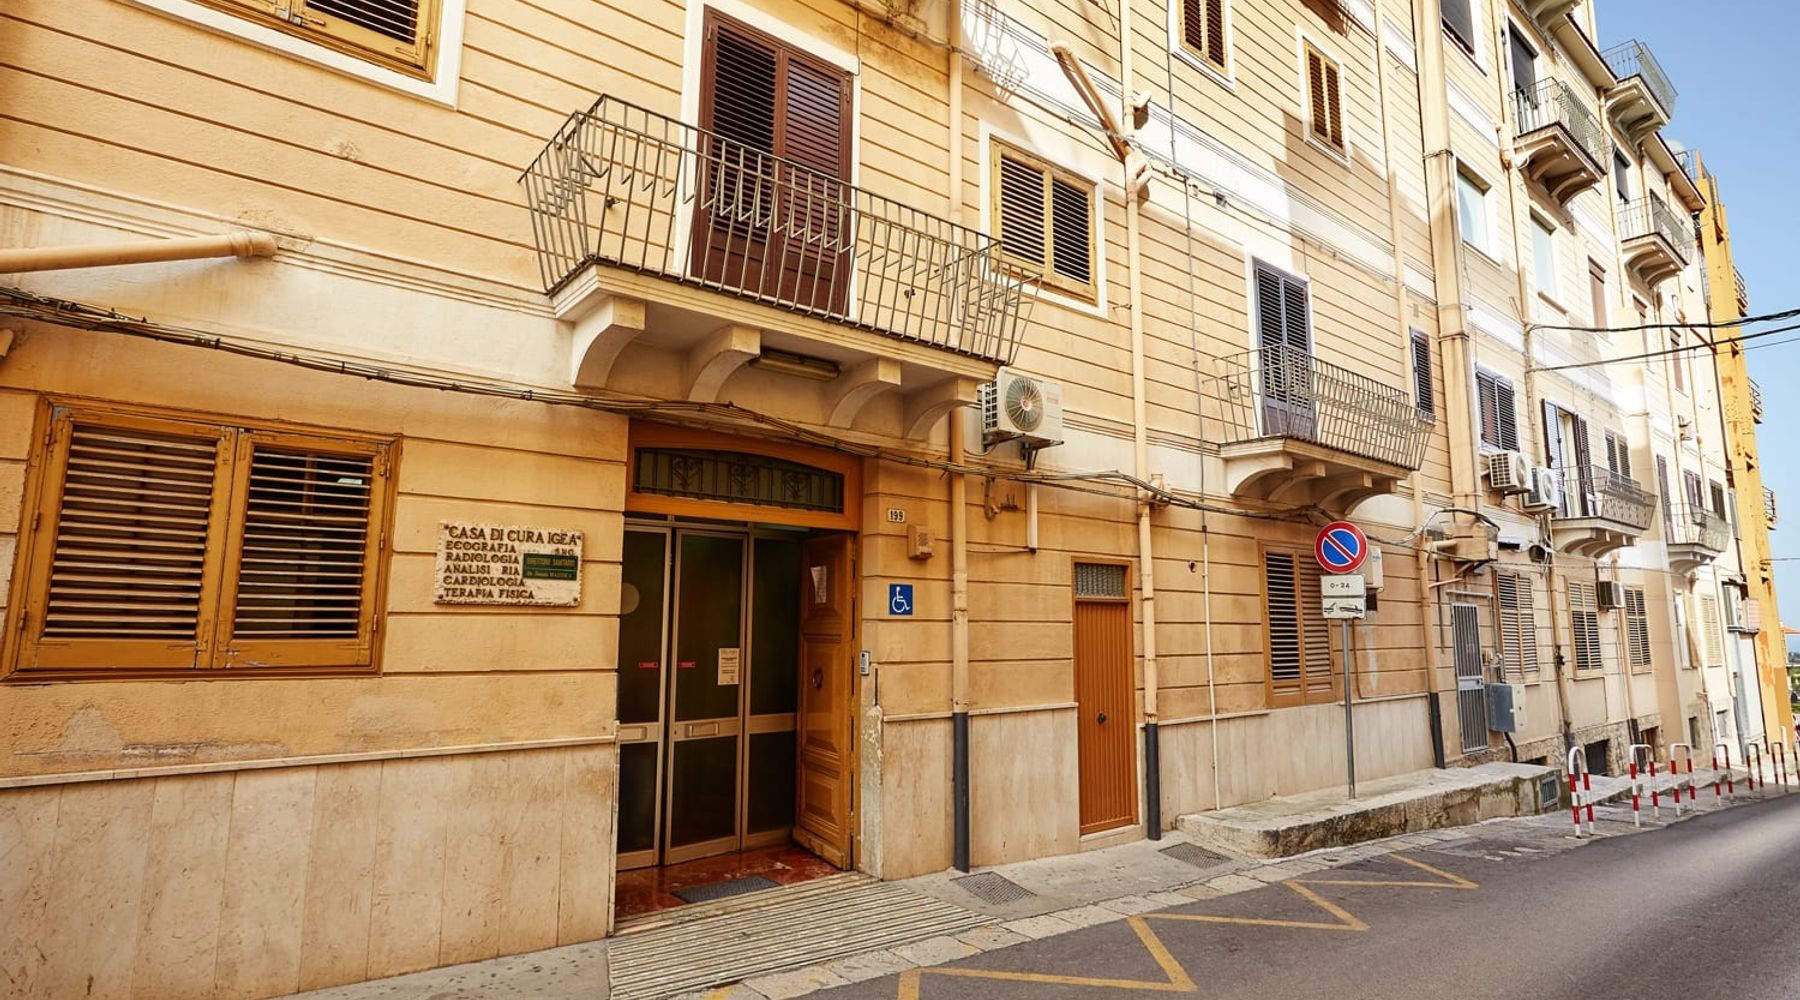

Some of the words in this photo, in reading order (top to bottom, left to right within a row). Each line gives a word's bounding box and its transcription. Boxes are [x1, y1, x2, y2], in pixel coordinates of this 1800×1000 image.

[890, 510, 903, 521] 199
[448, 526, 486, 540] CASA
[490, 528, 504, 541] DI
[507, 530, 545, 544] CURA
[547, 532, 577, 546] IGEA
[446, 540, 516, 554] ECOGRAFIA
[445, 552, 520, 565] RADIOLOGIA
[443, 564, 490, 574] ANALISI
[501, 566, 520, 576] RIA
[443, 575, 526, 587] CARDIOLOGIA
[443, 587, 494, 598] TERAPIA
[498, 589, 535, 599] FISICA
